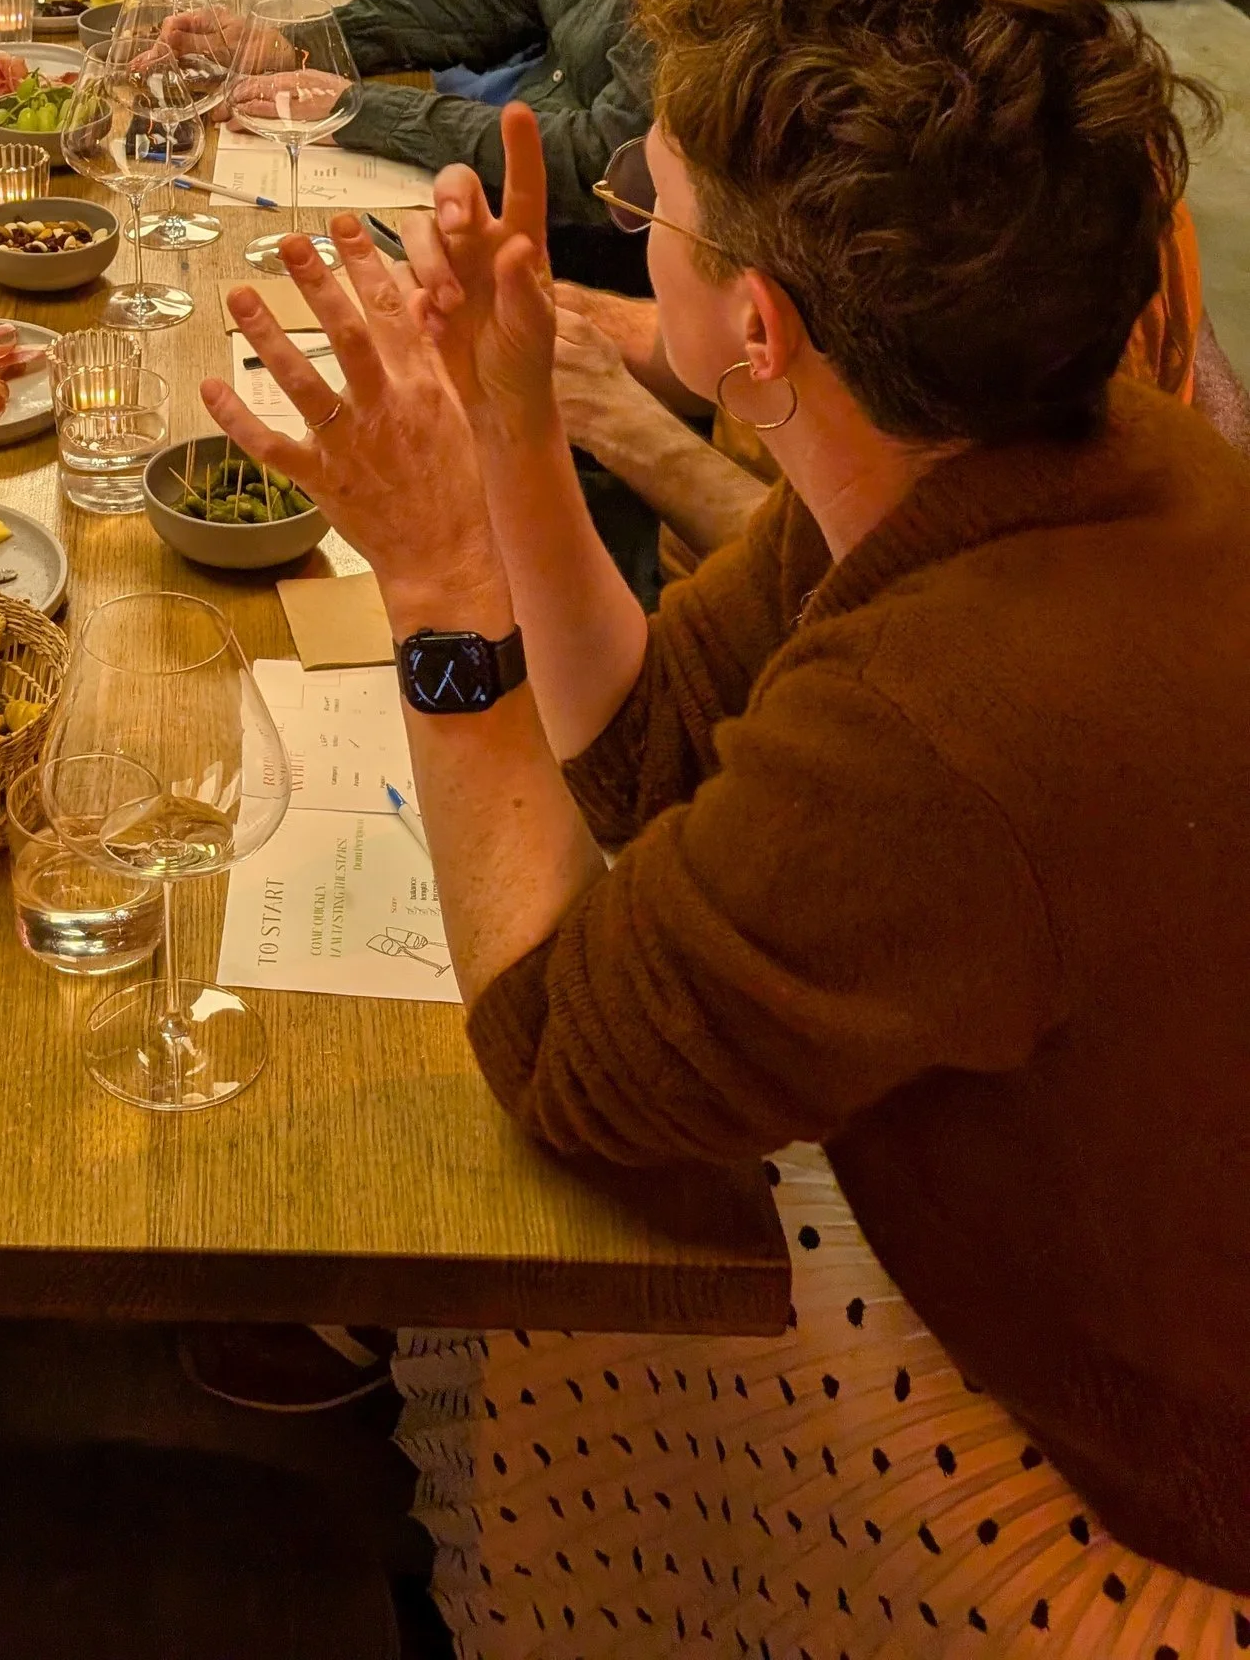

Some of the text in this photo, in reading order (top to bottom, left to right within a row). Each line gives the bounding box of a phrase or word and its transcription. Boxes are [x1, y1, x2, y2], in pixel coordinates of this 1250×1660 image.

[258, 877, 284, 966] TO START
[310, 929, 322, 957] COME
